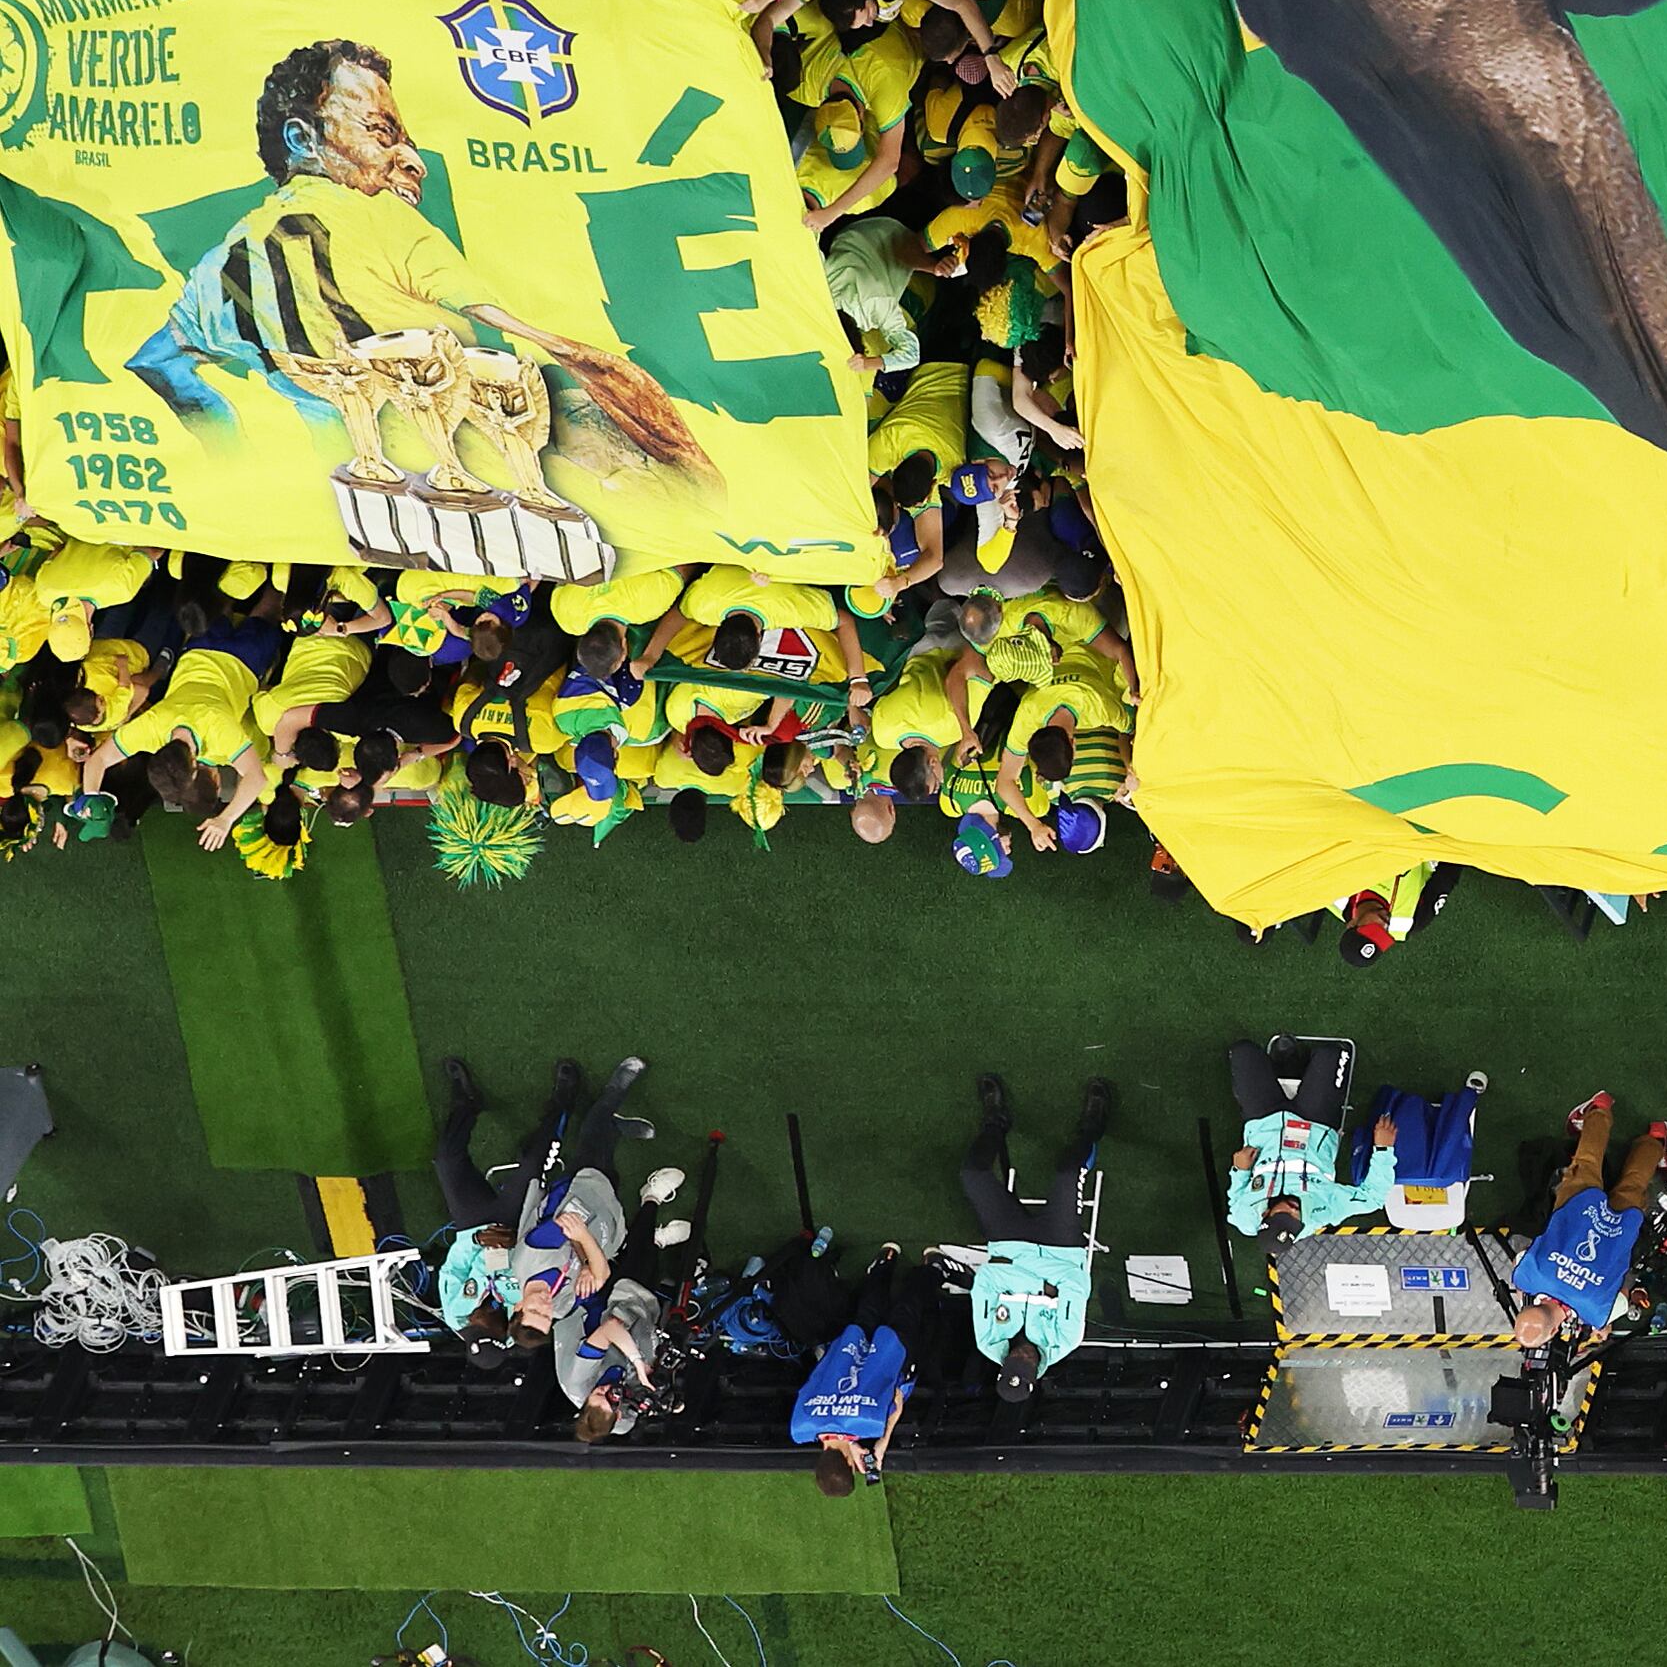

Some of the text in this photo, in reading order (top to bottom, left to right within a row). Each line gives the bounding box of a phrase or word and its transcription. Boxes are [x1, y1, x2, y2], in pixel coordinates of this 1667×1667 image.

[67, 24, 181, 88] VERDE
[491, 47, 540, 65] CBF
[48, 92, 202, 148] AMARELO
[75, 148, 112, 168] BRASIL
[468, 137, 609, 174] BRASIL
[54, 410, 160, 445] 1958
[66, 453, 172, 494] 1962
[74, 499, 187, 531] 1970
[1546, 1246, 1604, 1285] STUDIOS
[1554, 1266, 1587, 1292] FIFA
[809, 1403, 859, 1416] FIFA TV
[837, 1393, 877, 1406] TEAM
